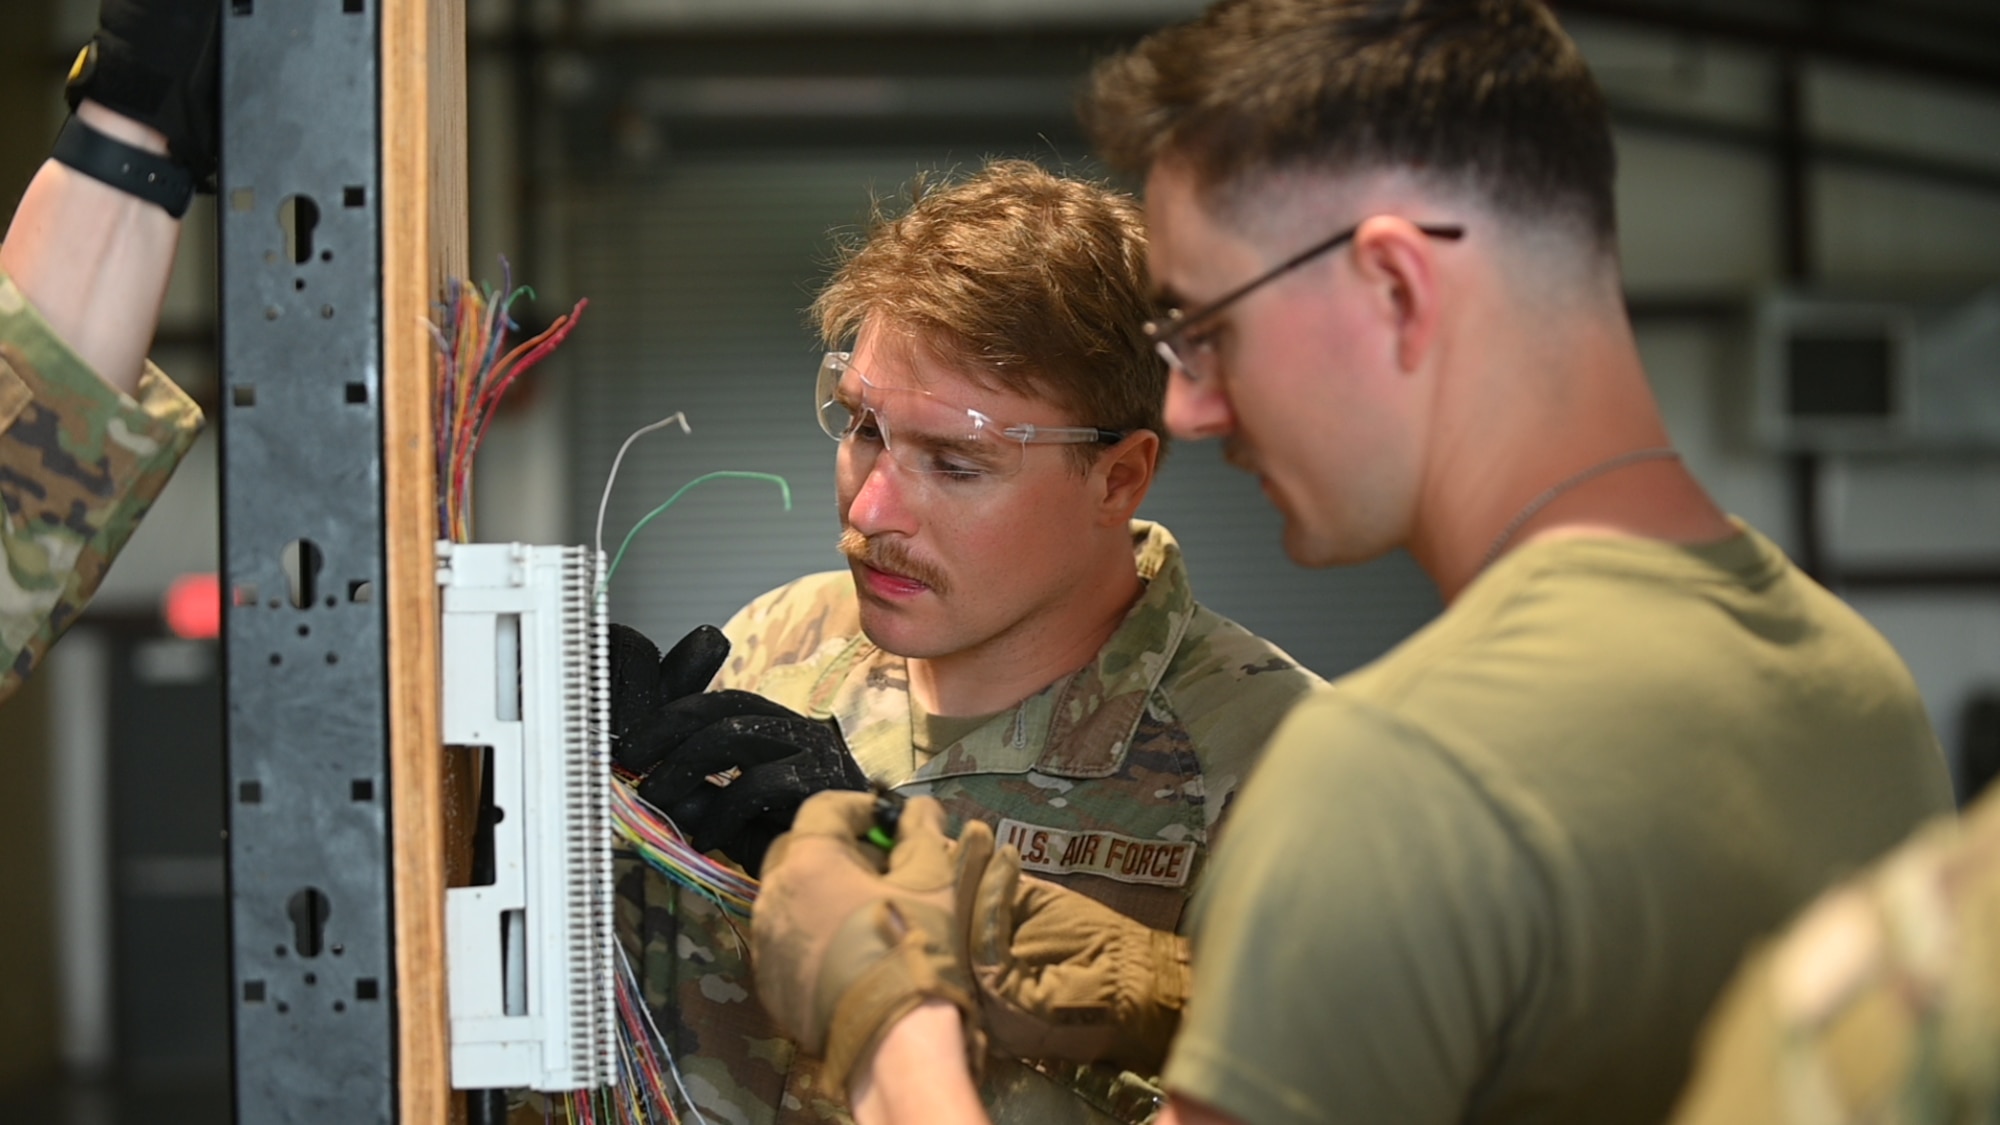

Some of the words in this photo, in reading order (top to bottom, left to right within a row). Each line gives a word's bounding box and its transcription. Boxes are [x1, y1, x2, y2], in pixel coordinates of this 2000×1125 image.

[1008, 826, 1050, 864] U.S.
[1060, 834, 1101, 866] AIR
[1105, 838, 1185, 878] FORCE
